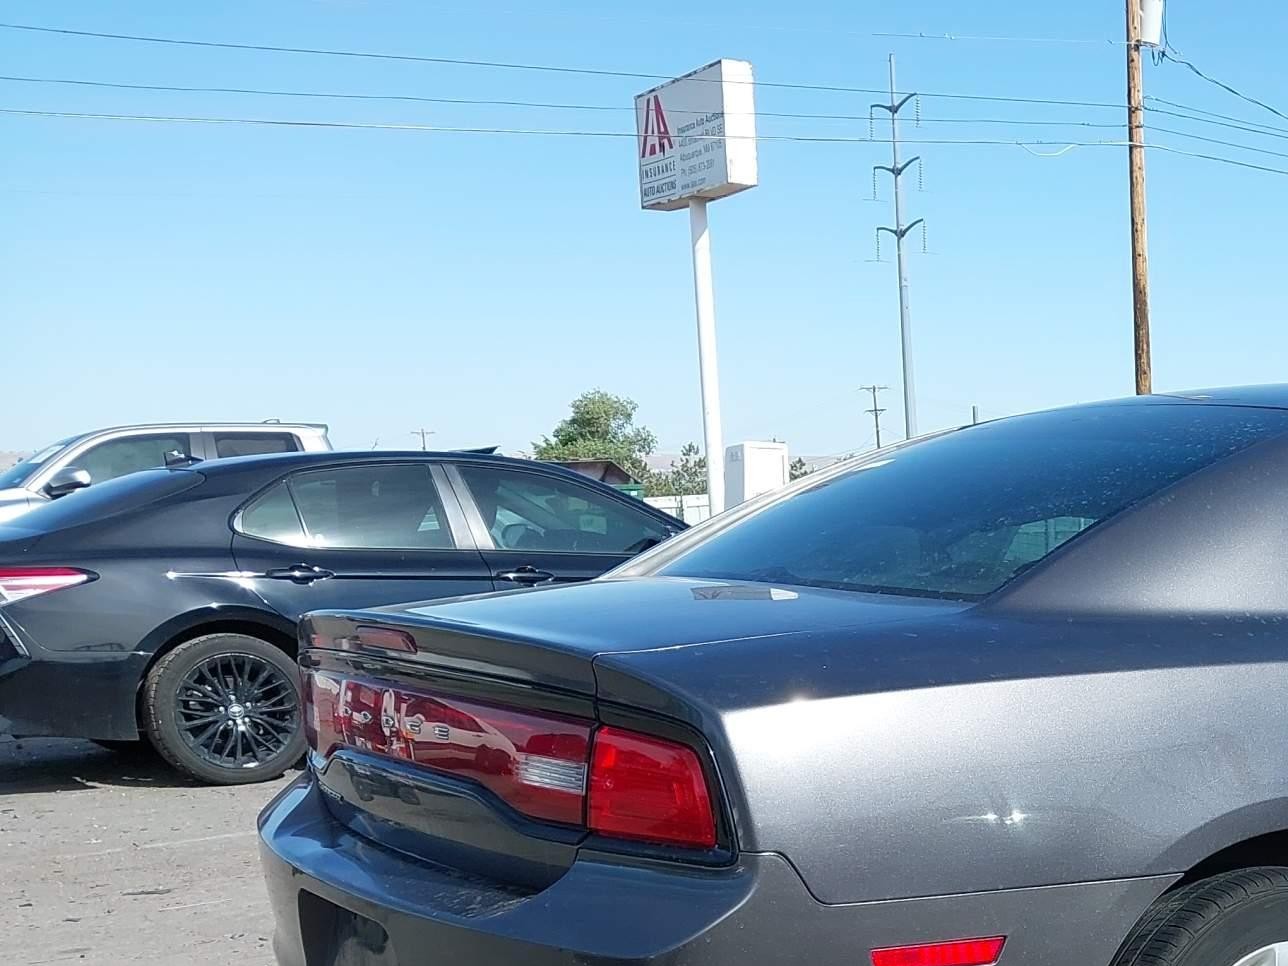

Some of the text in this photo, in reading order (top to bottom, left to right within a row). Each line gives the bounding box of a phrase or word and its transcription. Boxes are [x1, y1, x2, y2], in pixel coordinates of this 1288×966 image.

[641, 160, 677, 181] INSURANCE
[643, 179, 677, 198] AUTO AUCTIONS
